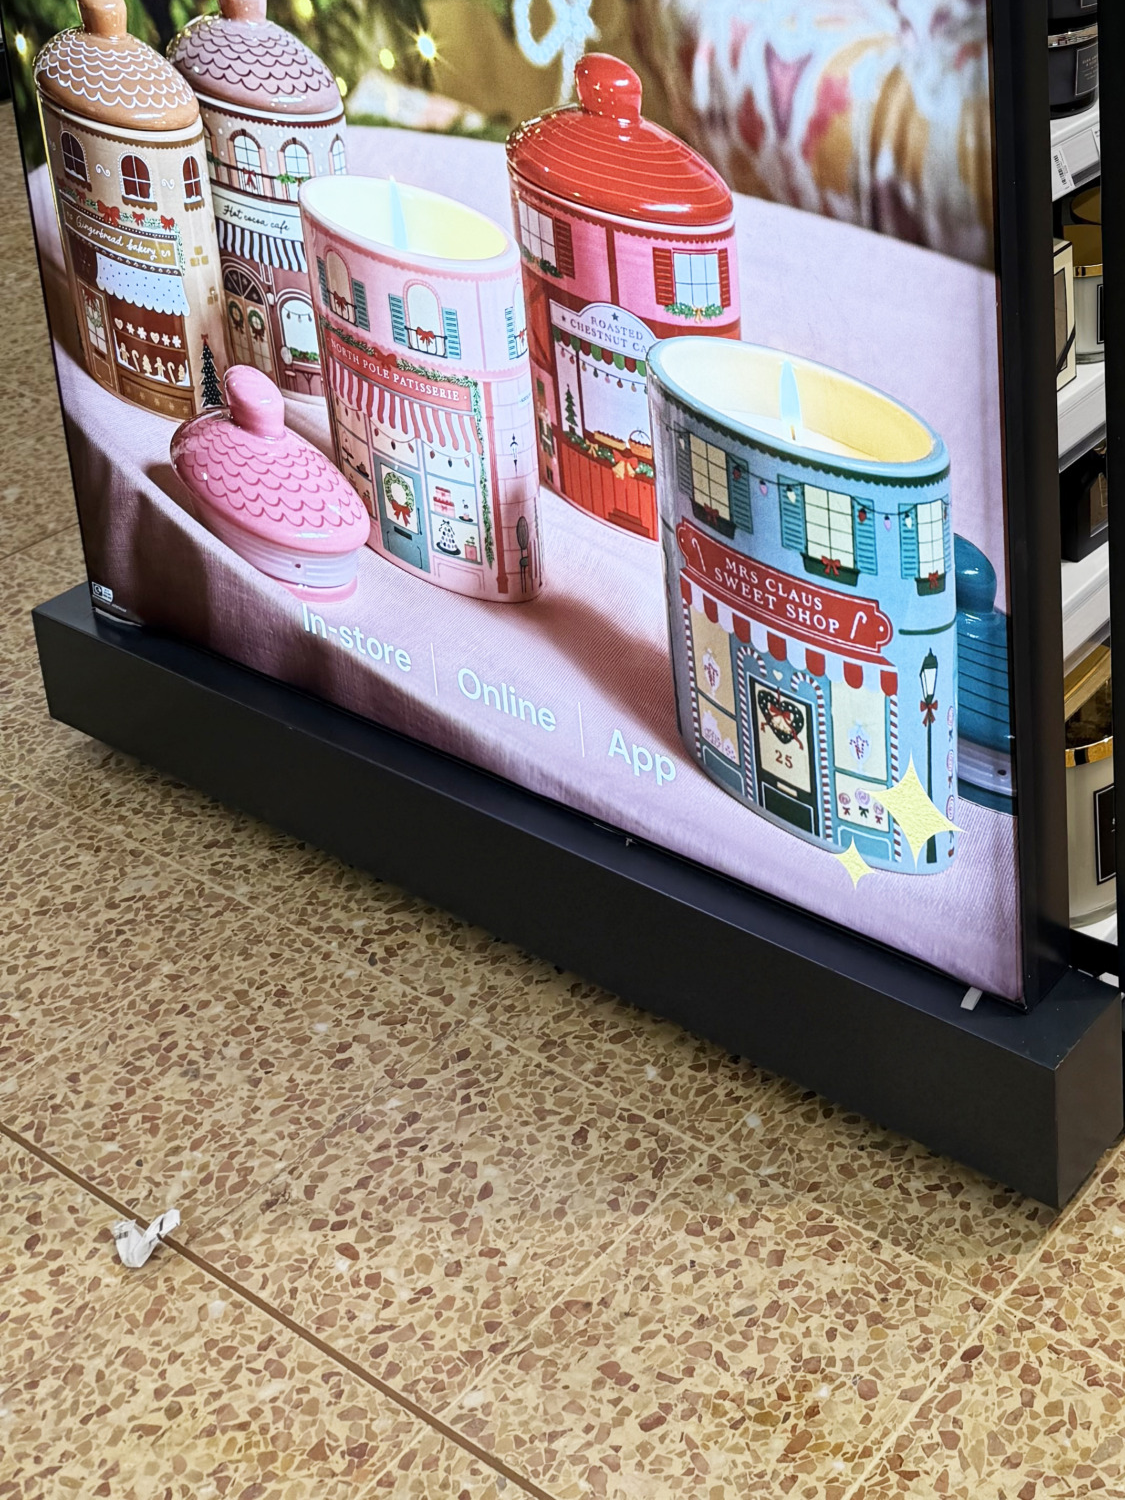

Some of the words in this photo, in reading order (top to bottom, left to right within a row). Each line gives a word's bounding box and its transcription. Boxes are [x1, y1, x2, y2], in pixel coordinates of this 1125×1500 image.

[76, 211, 124, 247] Gingerbread
[126, 236, 158, 261] bakery
[223, 204, 242, 220] Hot
[243, 212, 268, 228] cocoa
[270, 218, 291, 232] cafe
[569, 318, 627, 348] CHESTNUT
[590, 315, 644, 341] ROASTED
[331, 339, 360, 366] NORTH
[362, 359, 390, 380] POLE
[392, 373, 460, 402] PATISSERIE
[714, 567, 777, 610] SWEET
[786, 602, 840, 635] SHOP
[726, 557, 759, 584] MRS
[765, 578, 823, 611] CLAUS
[301, 603, 413, 673] In-store
[456, 666, 558, 733] Online
[607, 728, 677, 786] App
[774, 749, 794, 770] 25
